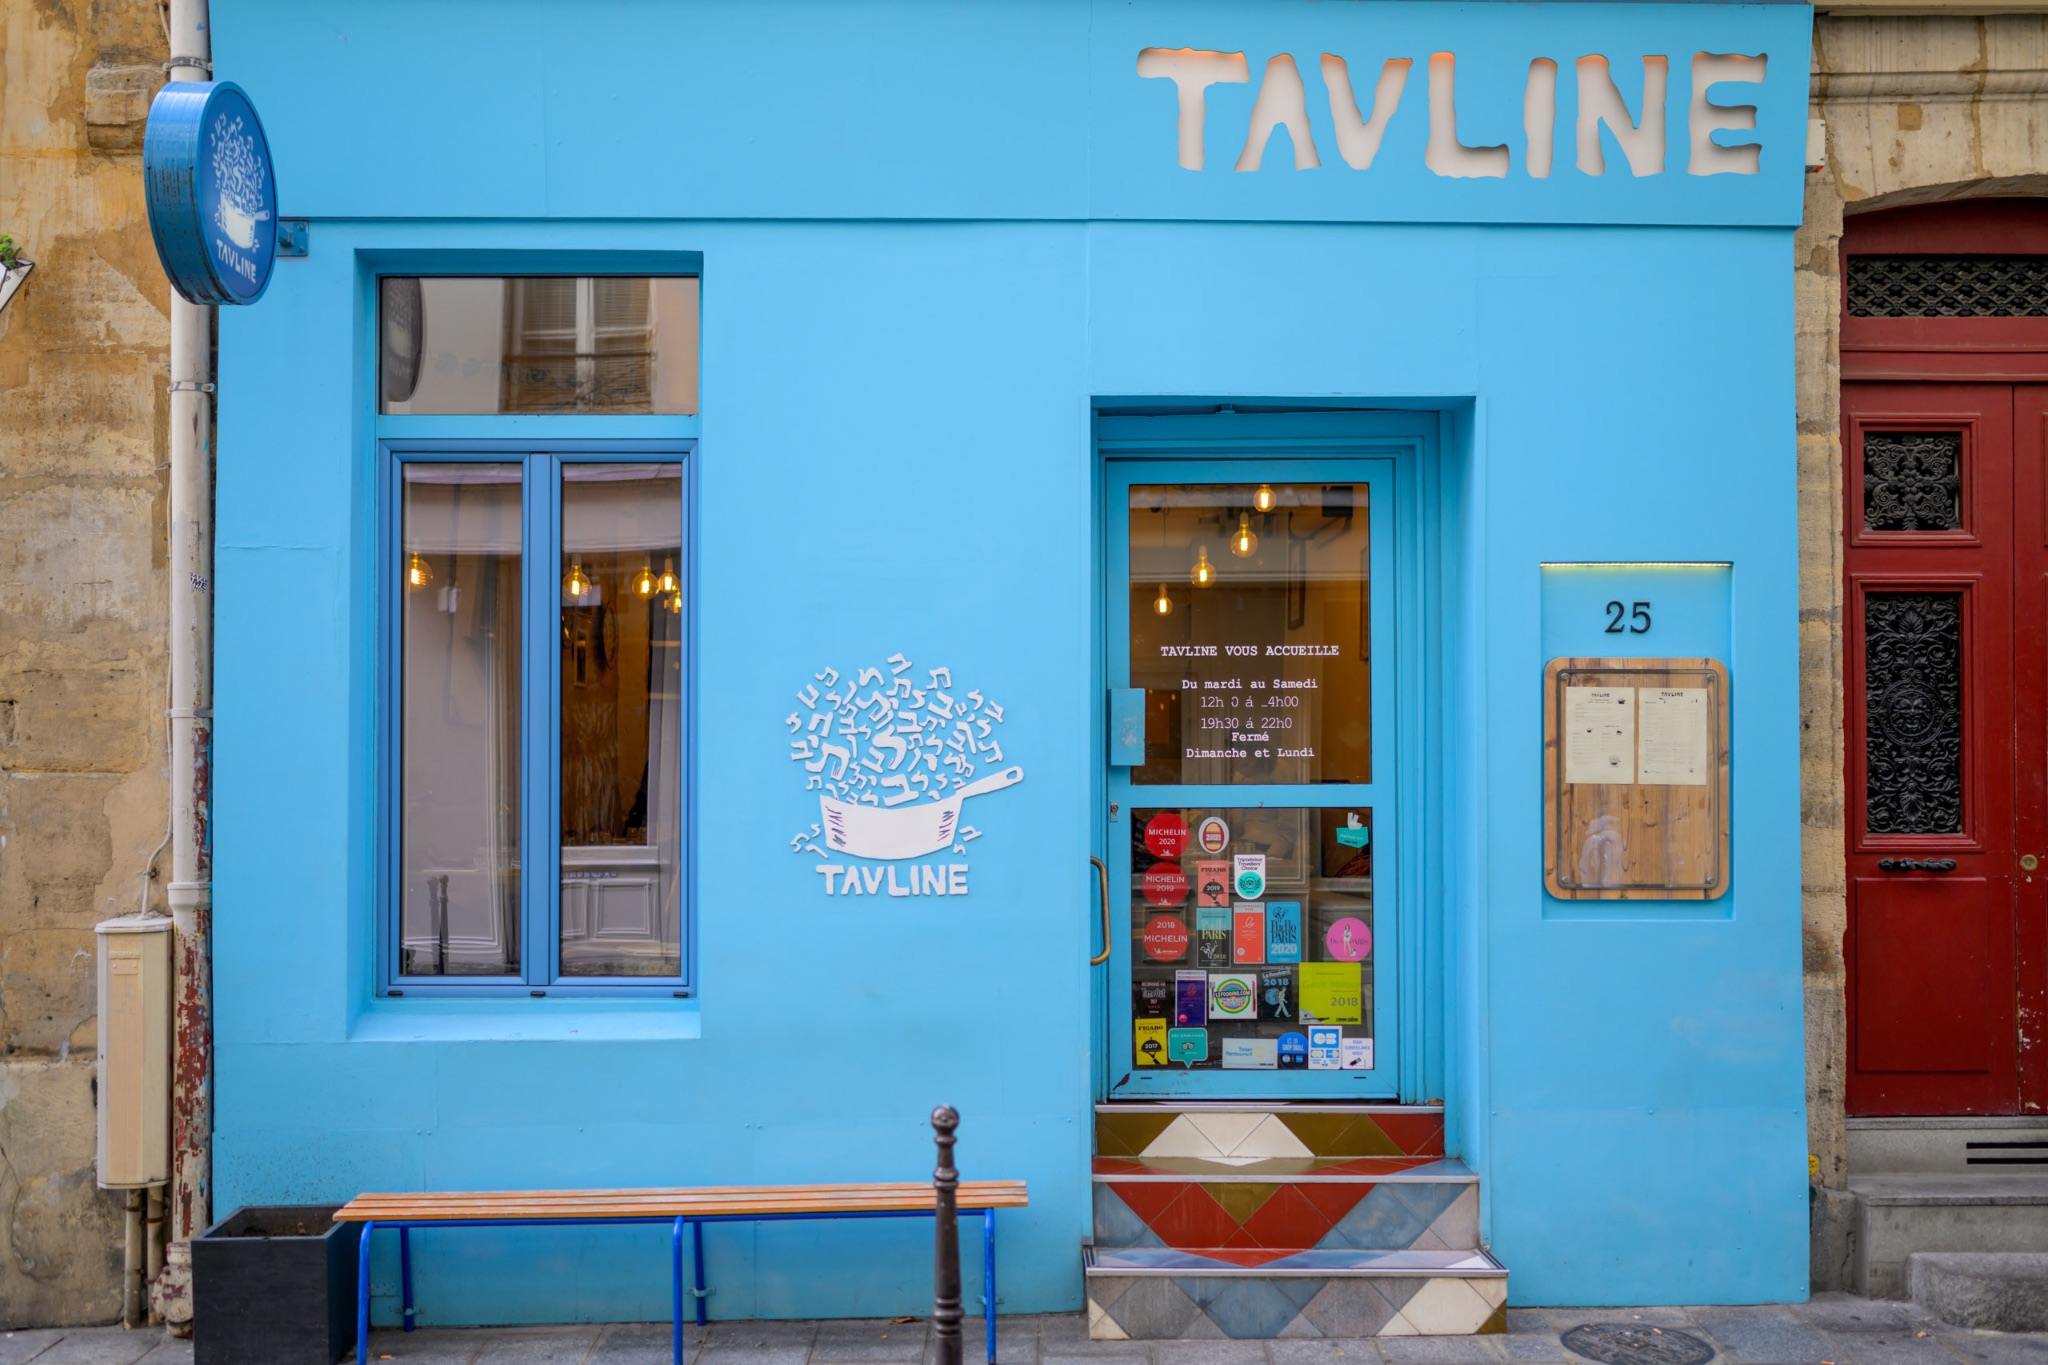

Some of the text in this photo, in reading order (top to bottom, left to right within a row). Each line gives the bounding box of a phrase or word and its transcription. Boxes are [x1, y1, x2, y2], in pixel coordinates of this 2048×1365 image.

[1136, 46, 1768, 178] TAVLINE
[216, 238, 257, 284] TAVLINE
[1604, 600, 1651, 634] 25
[1160, 645, 1339, 657] TAVLINE VOUS ACCUEILLE
[1182, 679, 1318, 689] Du mardi au Samedi
[1200, 717, 1239, 729] 19h30
[1231, 731, 1269, 742] Fermé
[1186, 748, 1315, 758] Dimanche et Lundi
[815, 863, 969, 897] TAVLINE
[1146, 875, 1185, 883] MICHELIN
[1156, 921, 1175, 929] 2018
[1144, 935, 1188, 943] MICHELIN
[1201, 930, 1227, 940] PARIS
[1271, 931, 1297, 944] PARIS
[1271, 943, 1298, 955] 2020
[1263, 978, 1290, 986] 2018
[1330, 996, 1359, 1007] 2018
[1313, 1032, 1337, 1045] CB
